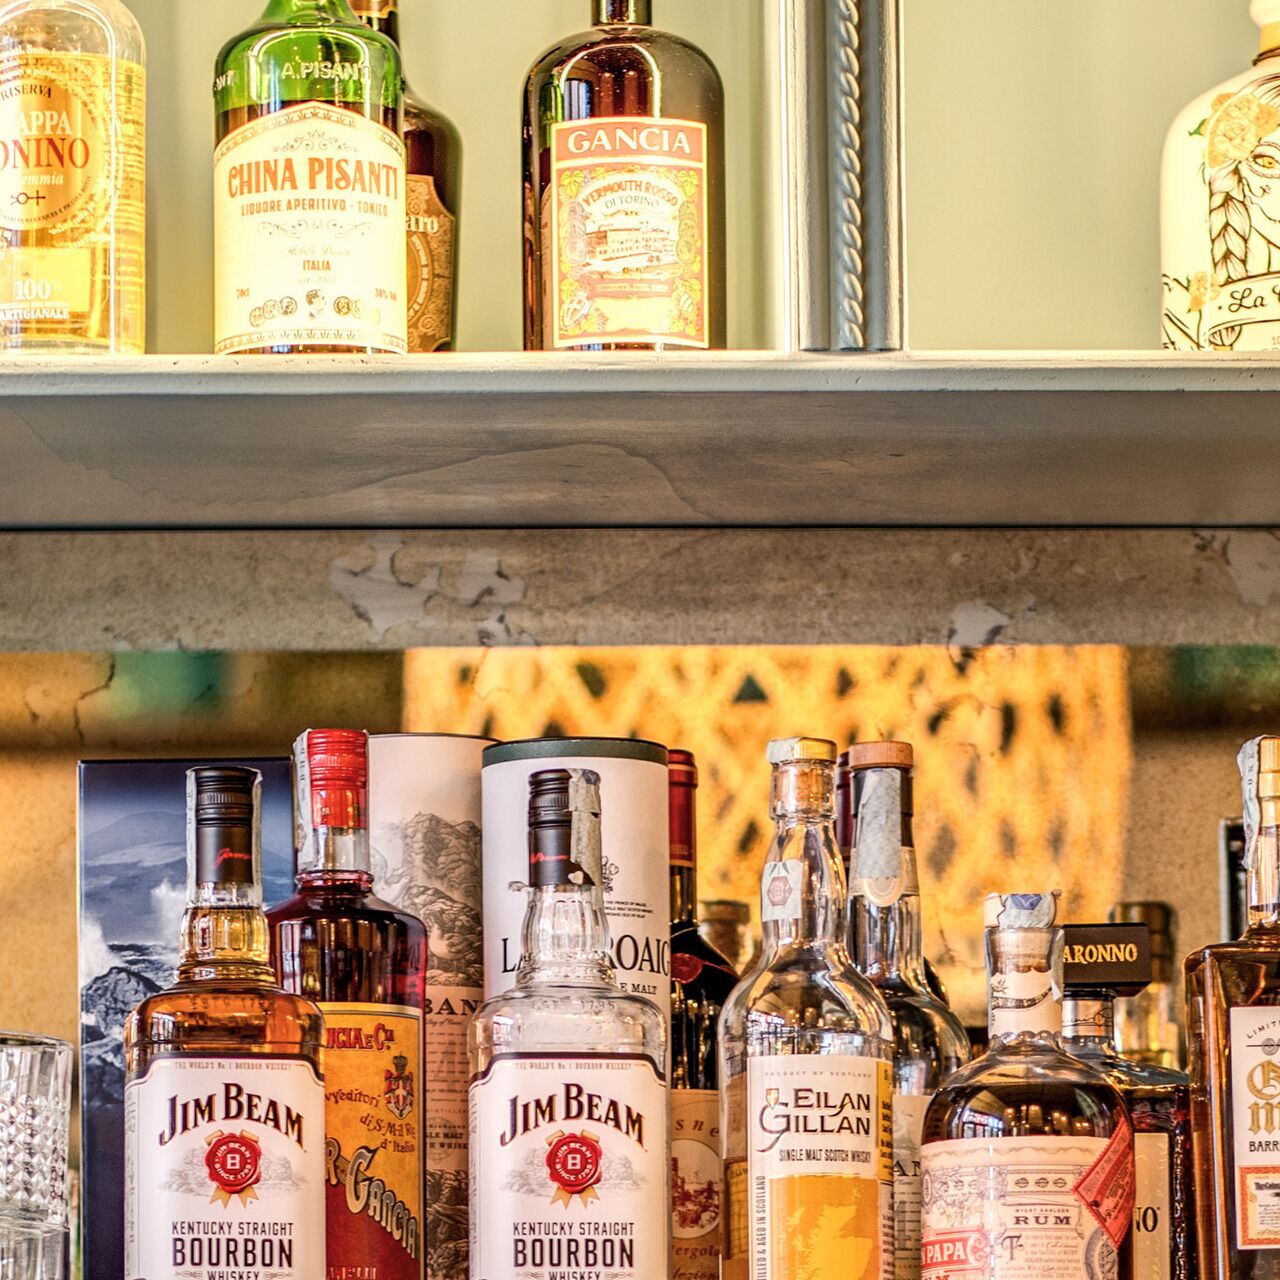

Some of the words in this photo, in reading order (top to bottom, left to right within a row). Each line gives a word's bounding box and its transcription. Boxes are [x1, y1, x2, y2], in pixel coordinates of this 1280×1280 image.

[282, 61, 368, 81] A.PISANT
[1, 84, 51, 101] RISERVA
[19, 111, 73, 136] APPA
[568, 127, 692, 155] GANCIA
[228, 157, 299, 198] CHINA
[308, 156, 399, 200] PISANTI
[582, 180, 643, 207] VERMOUTH
[644, 181, 679, 207] ROSSO
[605, 199, 617, 209] DI
[619, 194, 660, 208] TORINO
[241, 200, 283, 217] LIQUORE
[286, 198, 347, 213] APERITIVO
[358, 200, 389, 218] TONICO
[406, 215, 439, 234] aro
[302, 259, 332, 272] ITALIA
[1228, 287, 1268, 313] La
[1063, 943, 1138, 964] ARONNO
[631, 982, 658, 995] MALT
[425, 998, 479, 1016] BAN
[326, 1027, 362, 1049] NCIA
[829, 1071, 872, 1079] SCOTLAND
[793, 1088, 870, 1117] EILAN
[158, 1093, 217, 1147] JIM
[222, 1082, 305, 1149] BEAM
[499, 1094, 558, 1147] JIM
[562, 1082, 646, 1149] BEAM
[674, 1117, 720, 1138] sne
[756, 1101, 870, 1153] GILLAN
[215, 1144, 228, 1158] JIM
[228, 1142, 250, 1159] BEAM
[556, 1144, 569, 1158] JIM
[569, 1142, 593, 1159] BEAM
[779, 1148, 803, 1162] SINGLE
[805, 1148, 823, 1162] MALT
[824, 1148, 849, 1162] SCOTCH
[851, 1149, 871, 1164] WHISKY
[226, 1153, 241, 1170] B
[567, 1153, 581, 1170] B
[214, 1163, 236, 1182] SINCE
[555, 1163, 577, 1182] SINCE
[755, 1175, 766, 1214] SCOTLAND
[171, 1221, 234, 1236] KENTUCKY
[238, 1221, 294, 1237] STRAIGHT
[513, 1221, 574, 1236] KENTUCKY
[579, 1221, 635, 1237] STRAIGHT
[756, 1216, 767, 1225] IN
[1013, 1215, 1072, 1225] RUM
[756, 1226, 767, 1246] AGED
[172, 1237, 293, 1268] BOURBON
[513, 1238, 634, 1268] BOURBON
